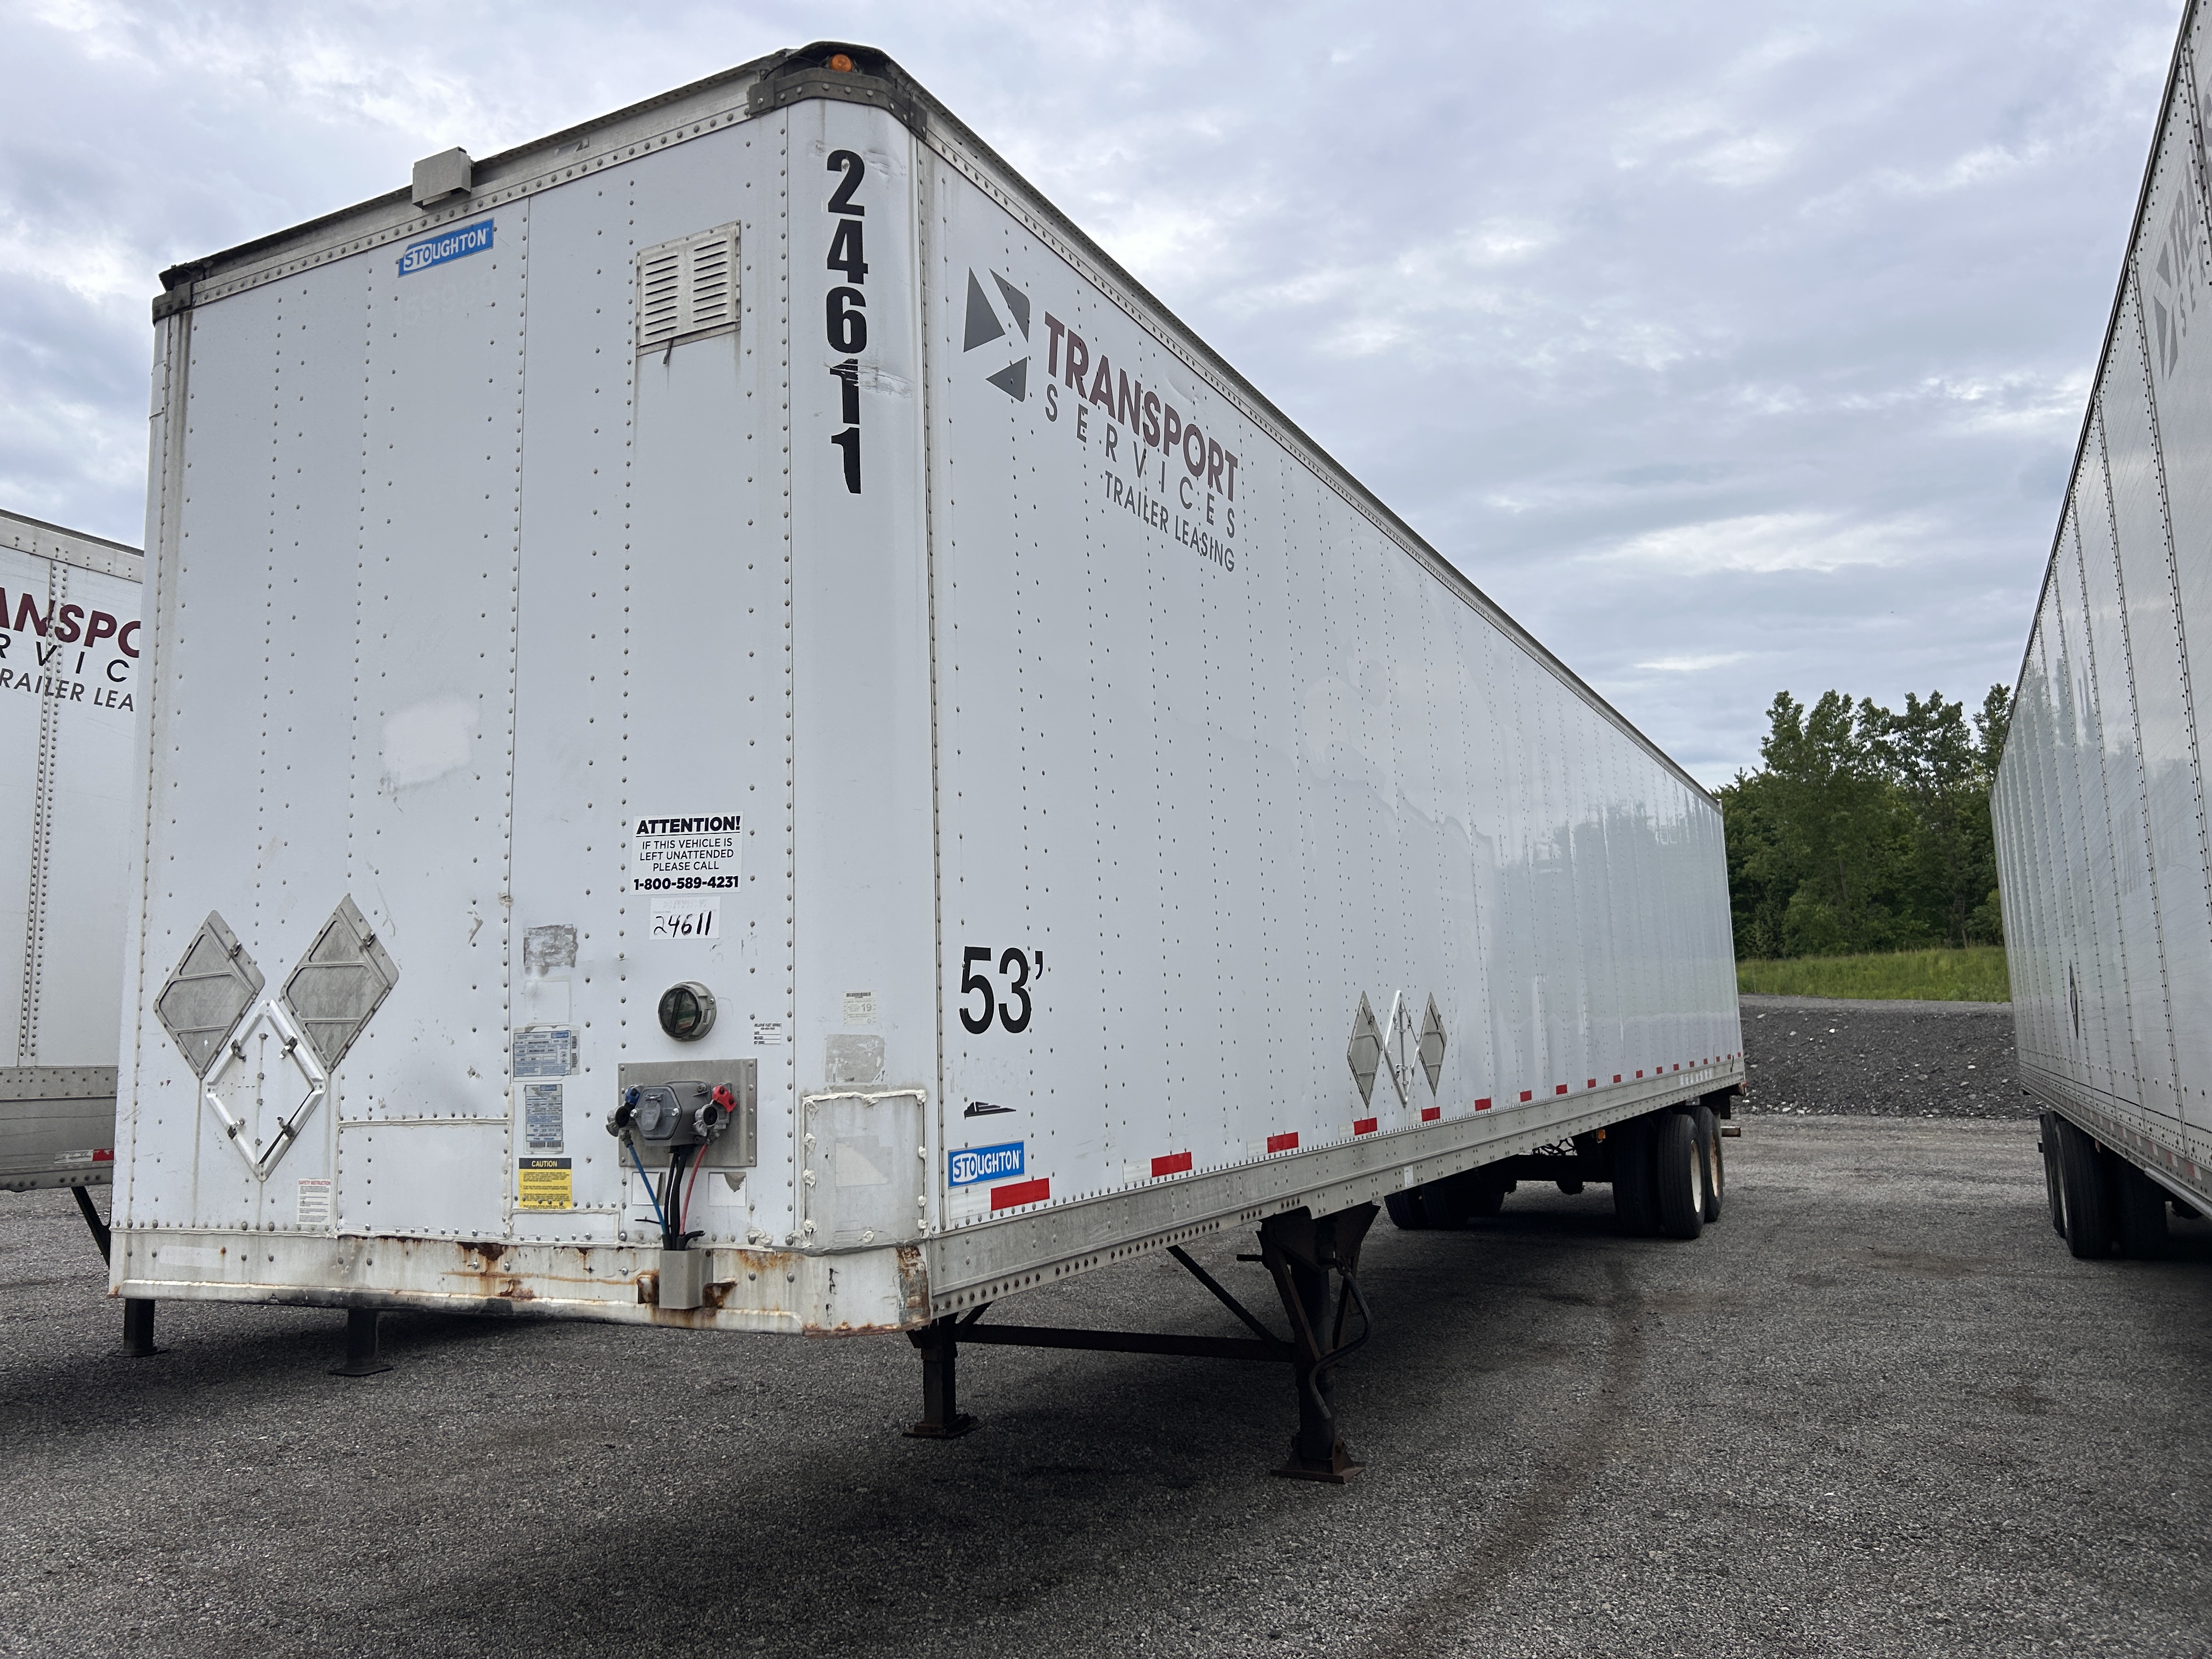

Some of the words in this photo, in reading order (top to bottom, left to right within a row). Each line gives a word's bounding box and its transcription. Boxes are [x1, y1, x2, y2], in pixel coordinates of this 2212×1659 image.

[405, 228, 487, 269] STOUGHTON
[827, 150, 868, 494] 24611
[1045, 311, 1238, 502] TRANSPORT
[1045, 383, 1235, 538] SERVICES
[1105, 470, 1169, 534] TRAILER
[1175, 515, 1235, 572] LEASING
[93, 687, 134, 712] LEA
[636, 816, 741, 834] ATTENTION!
[640, 851, 663, 861] LEFT
[666, 849, 734, 860] UNATTENDED
[642, 841, 651, 850] IF
[654, 840, 675, 849] THIS
[679, 838, 721, 849] VEHICLE
[724, 838, 732, 847] IS
[653, 861, 690, 871] PLEASE
[693, 861, 719, 870] CALL
[634, 876, 738, 890] 1-800-589-4231
[653, 910, 712, 938] 24611
[953, 1150, 1020, 1180] STOUGHTON
